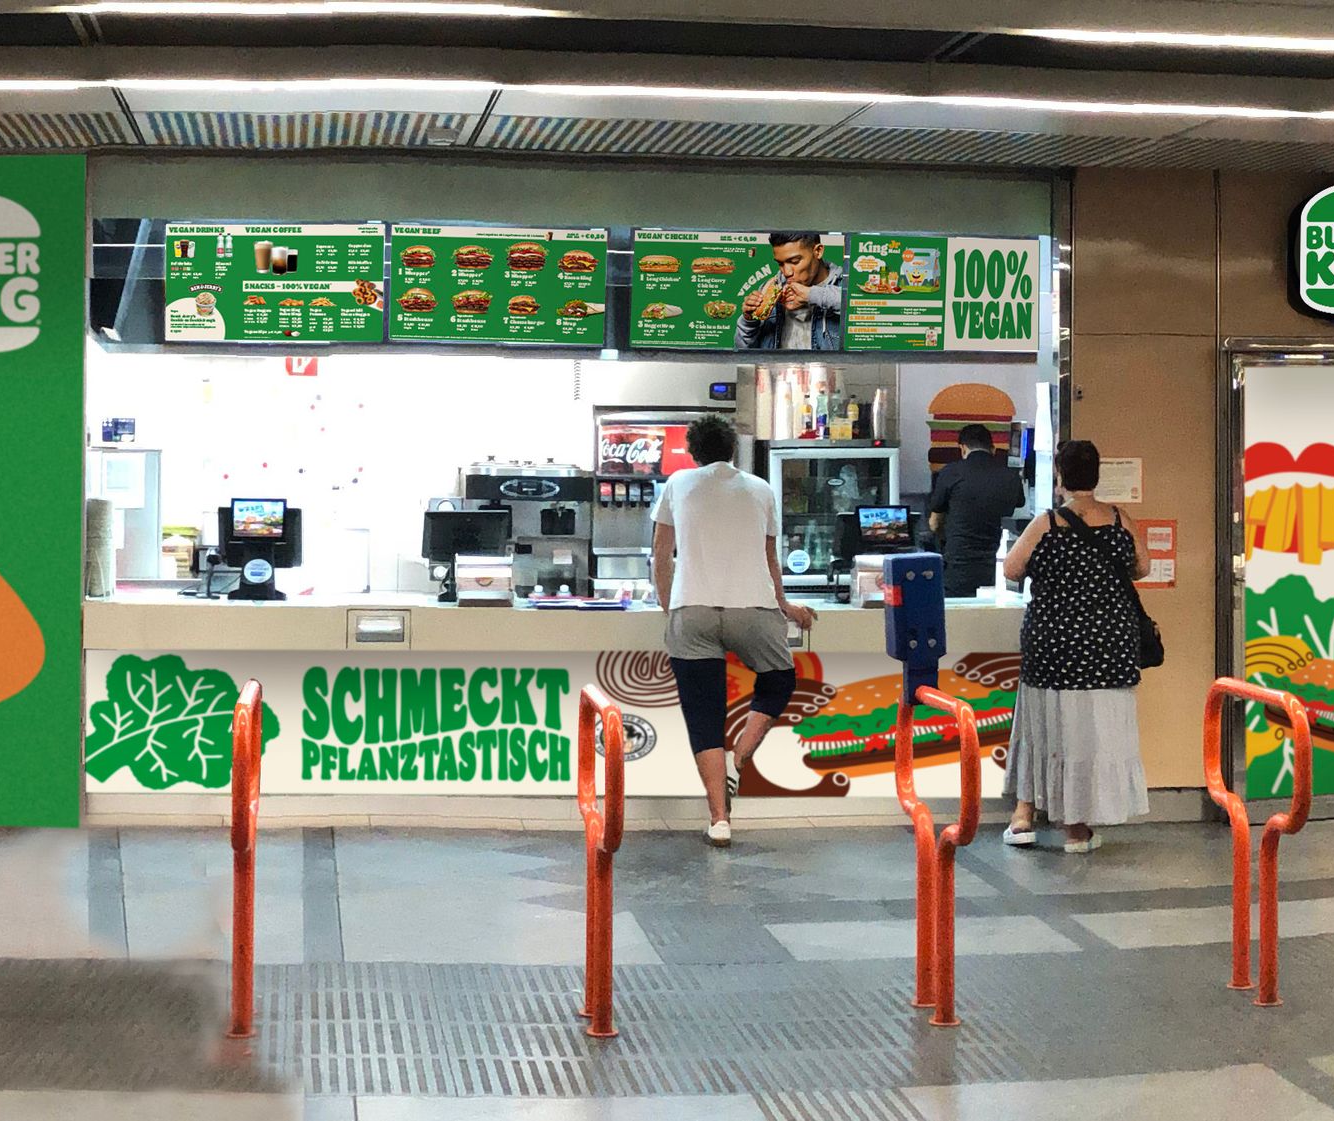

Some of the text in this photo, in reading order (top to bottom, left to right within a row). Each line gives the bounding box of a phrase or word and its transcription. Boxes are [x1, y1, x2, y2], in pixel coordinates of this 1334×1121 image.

[665, 233, 699, 241] CHICKEN
[858, 241, 888, 256] King
[244, 282, 275, 290] SNACKS
[282, 282, 303, 290] 100%
[737, 263, 773, 297] VEGAN
[953, 249, 1033, 300] 100%
[952, 301, 1033, 340] VEGAN
[302, 667, 570, 745] SCHMECKT
[302, 729, 571, 783] PFLANZTASTISCH
